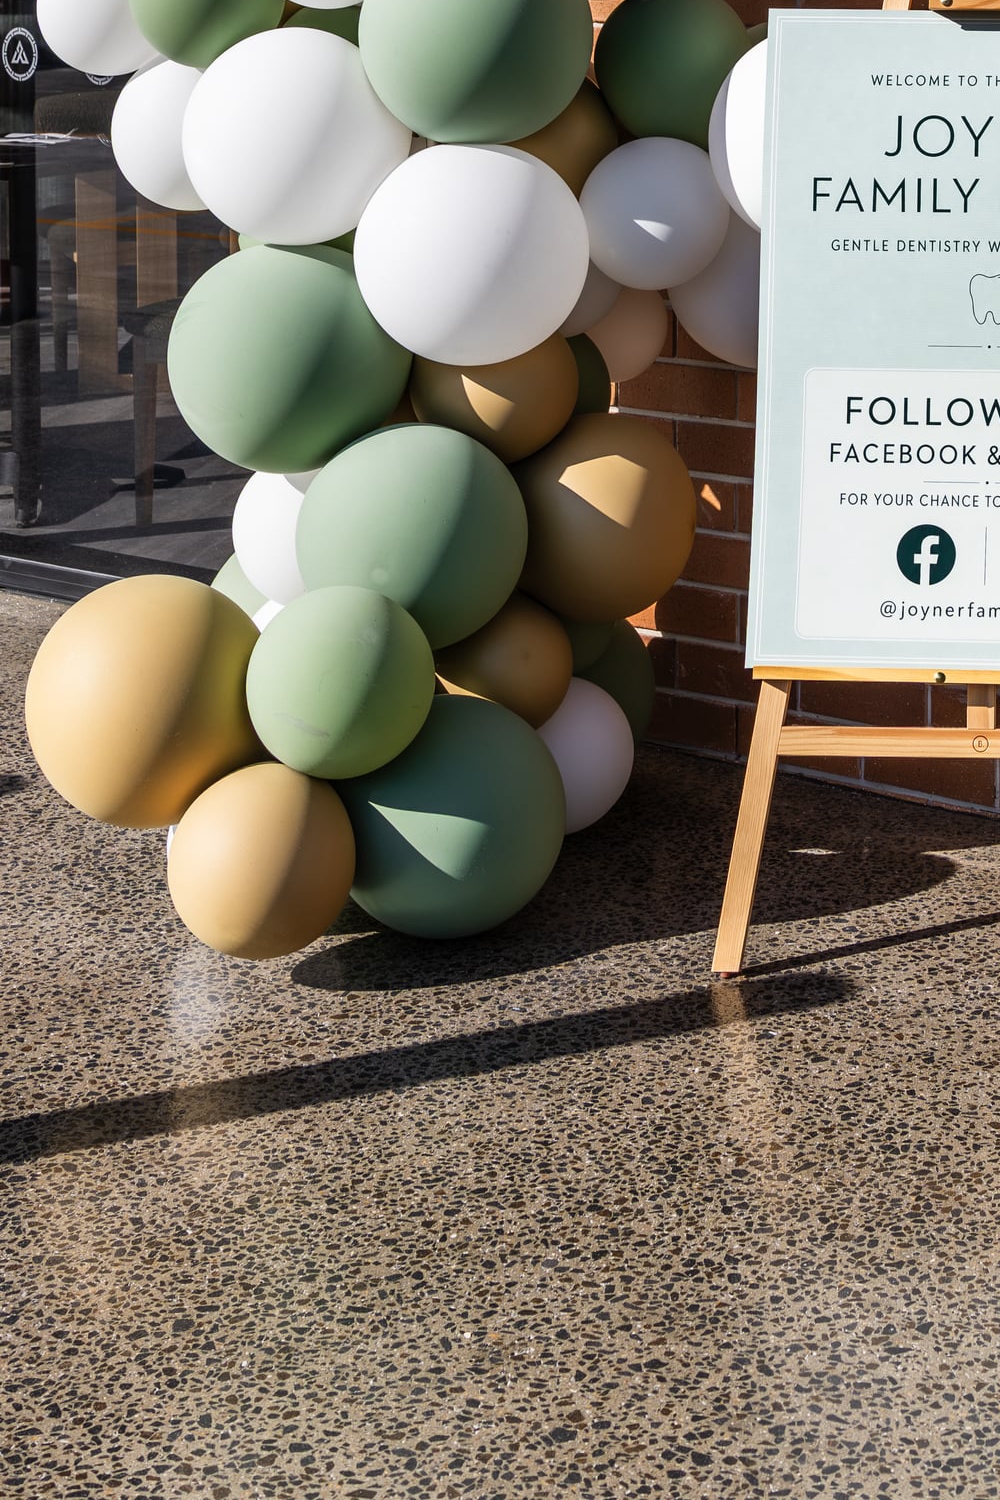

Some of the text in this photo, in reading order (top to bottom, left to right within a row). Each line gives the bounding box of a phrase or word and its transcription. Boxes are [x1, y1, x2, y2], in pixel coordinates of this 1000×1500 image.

[871, 74, 950, 87] WELCOME
[957, 75, 978, 87] TO
[812, 176, 981, 214] FAMILY
[831, 238, 889, 252] GENTLE
[896, 239, 981, 253] DENTISTRY
[830, 442, 977, 465] FACEBOOK
[839, 492, 868, 506] FOR
[873, 493, 914, 507] YOUR
[919, 494, 979, 508] CHANCE
